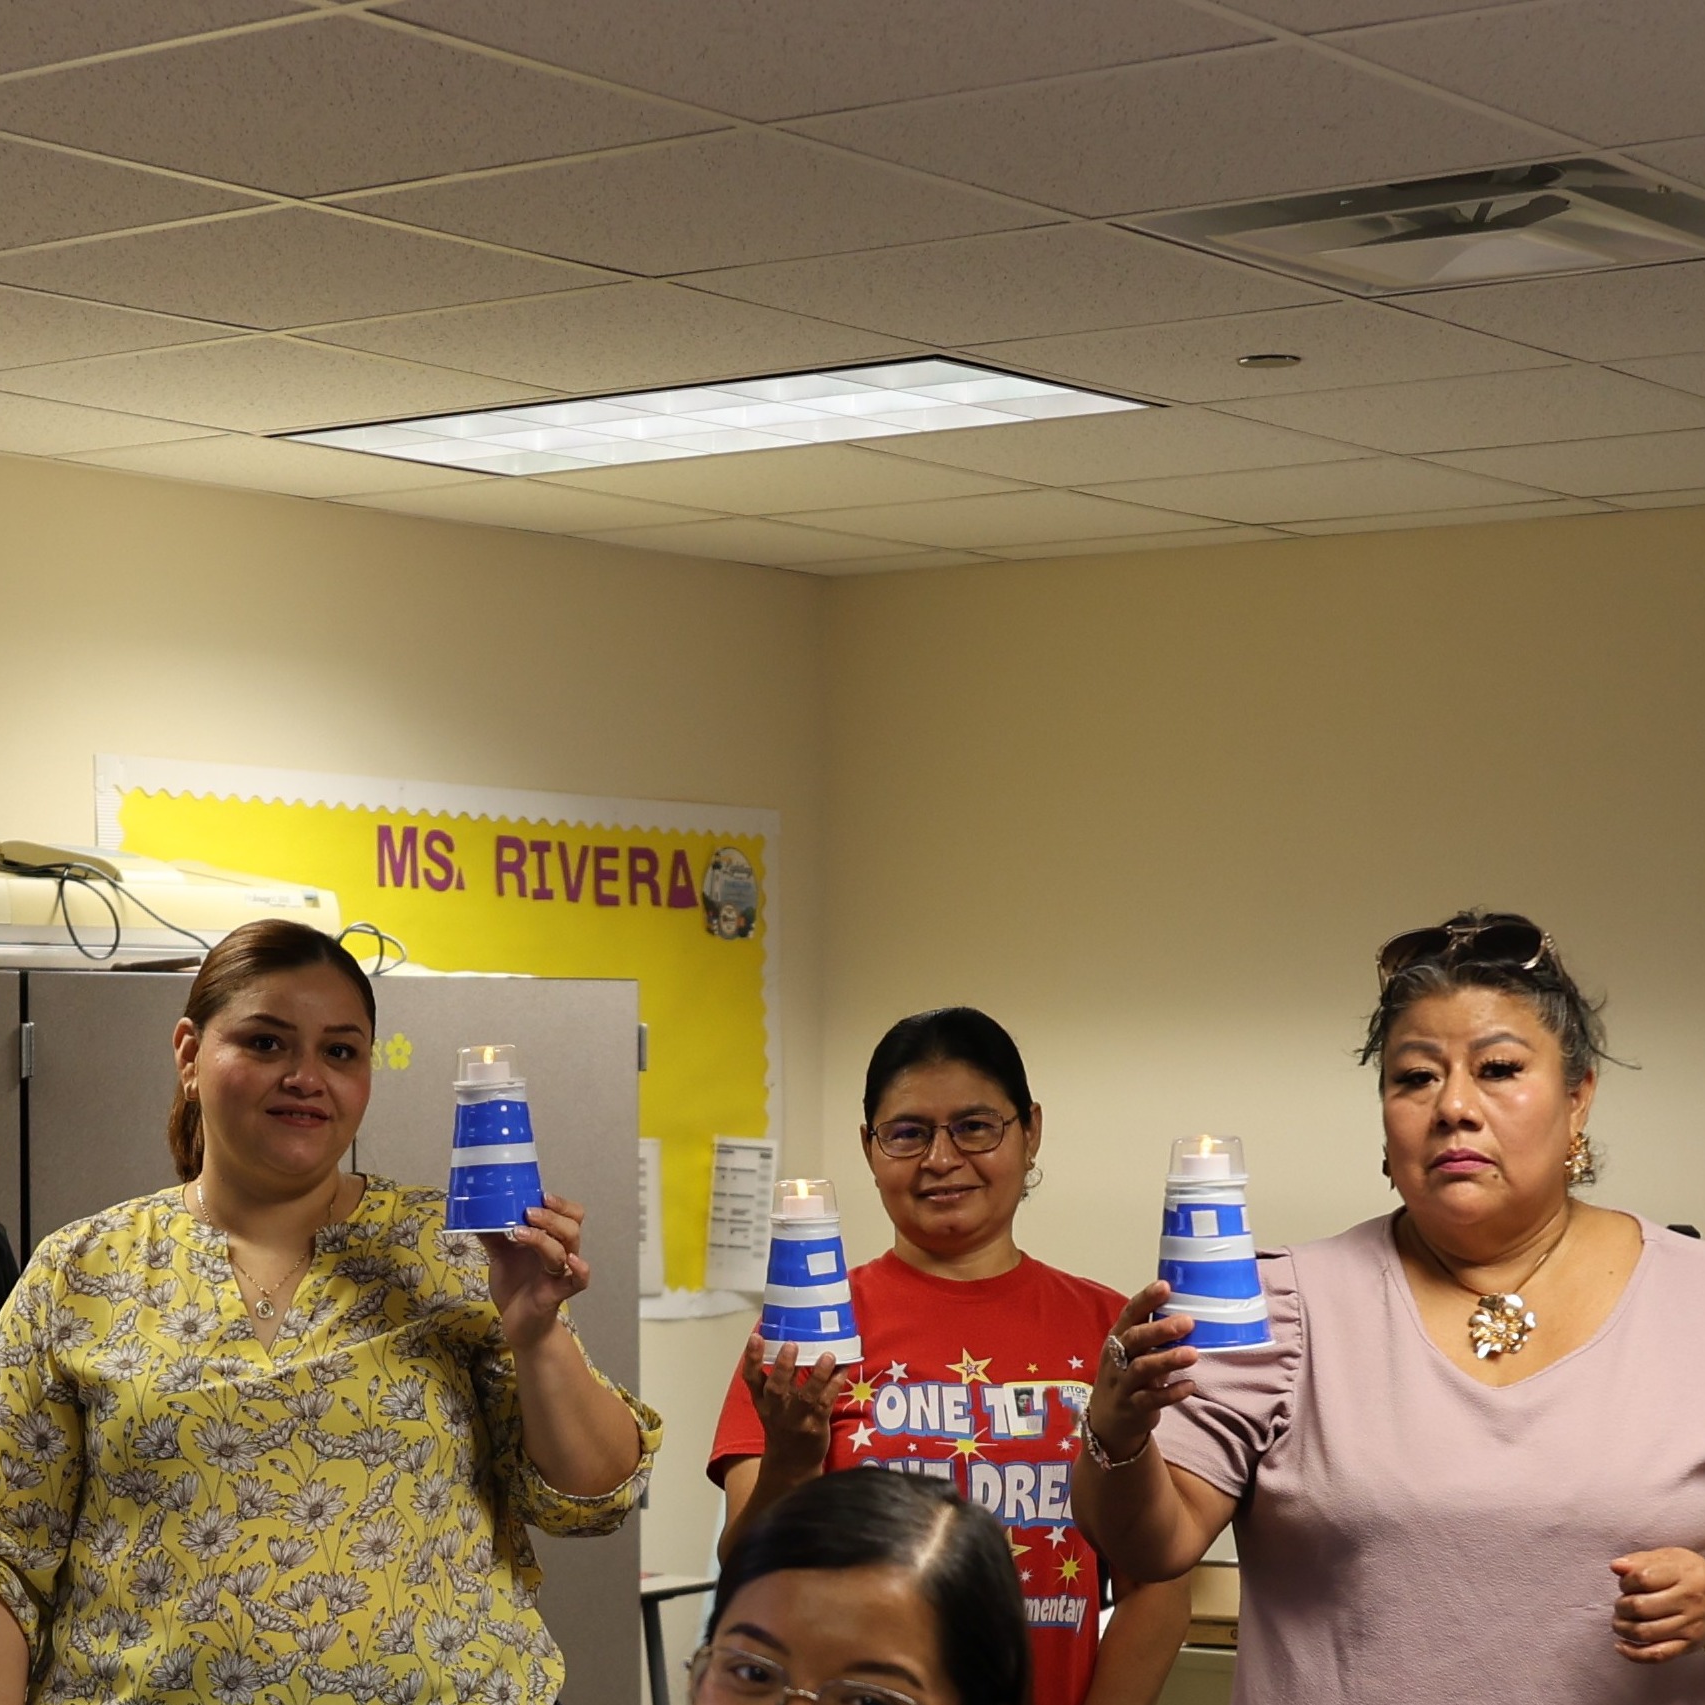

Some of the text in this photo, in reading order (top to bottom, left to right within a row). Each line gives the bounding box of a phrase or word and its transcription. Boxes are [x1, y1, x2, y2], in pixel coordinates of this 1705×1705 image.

[377, 825, 699, 909] MS. RIVERA
[875, 1383, 972, 1435] ONE
[969, 1463, 1074, 1521] DRE
[1025, 1595, 1087, 1633] mentary
